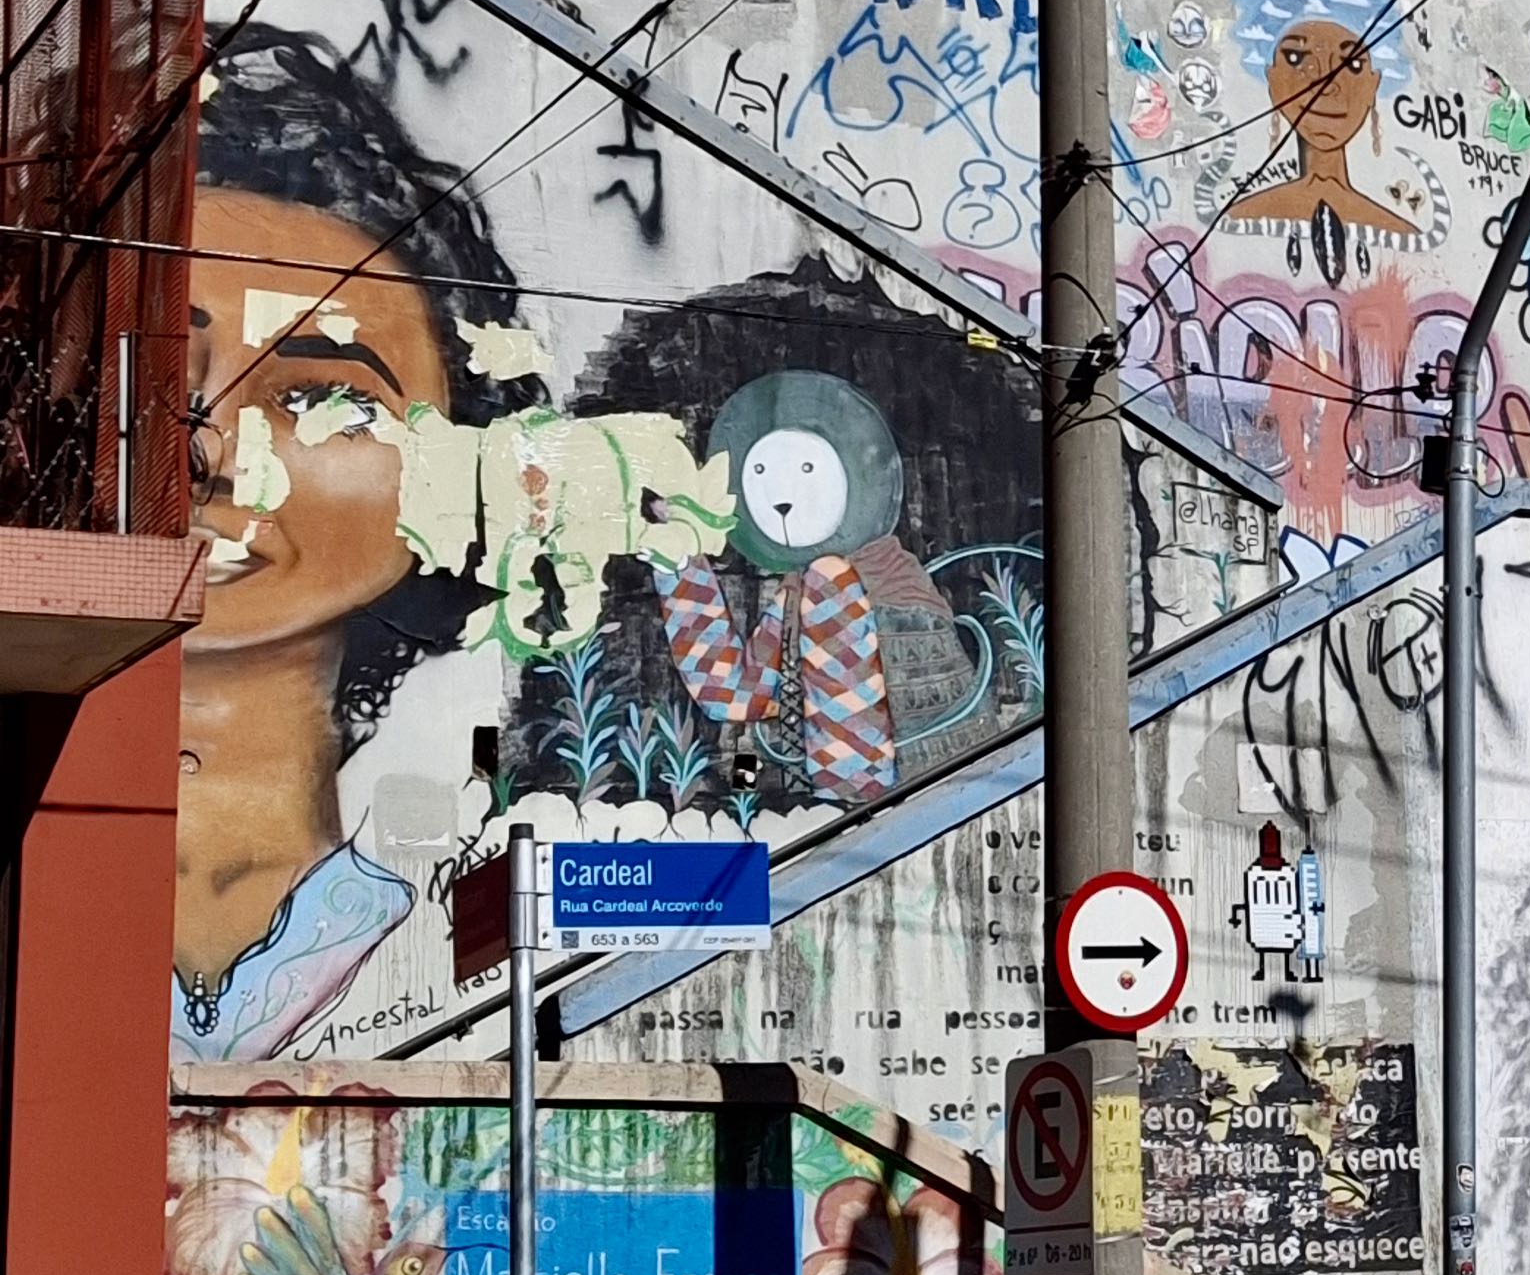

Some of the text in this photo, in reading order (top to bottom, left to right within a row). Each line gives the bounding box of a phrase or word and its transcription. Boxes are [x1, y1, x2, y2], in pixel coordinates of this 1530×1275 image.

[1460, 141, 1522, 177] BRUCE
[560, 858, 652, 886] Cardeal
[561, 900, 588, 913] Rua
[593, 899, 648, 913] Cardeal
[592, 933, 660, 946] 653 a 563
[640, 1008, 724, 1036] passa
[761, 1009, 795, 1030] na
[855, 1009, 902, 1030] rua
[1214, 999, 1277, 1024] trem
[880, 1049, 947, 1077] sabe
[456, 1204, 557, 1233] Escao
